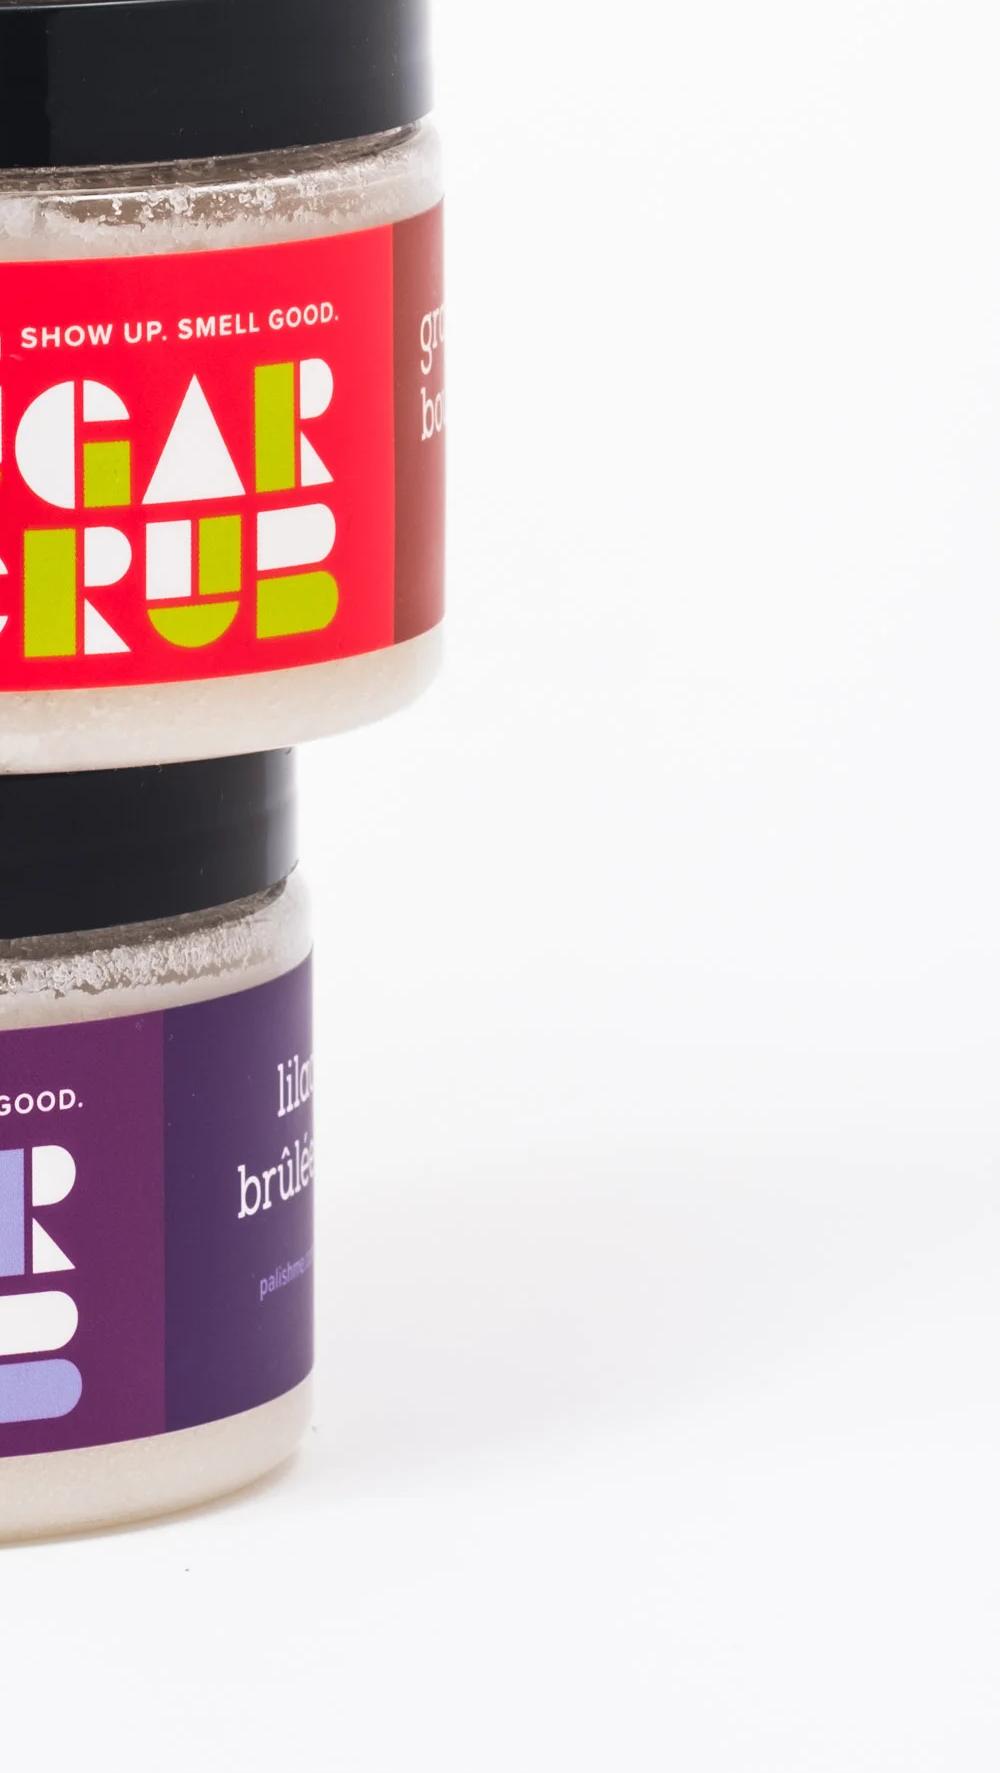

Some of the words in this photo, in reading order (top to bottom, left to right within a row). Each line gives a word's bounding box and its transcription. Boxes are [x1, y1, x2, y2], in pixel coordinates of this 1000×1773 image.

[21, 324, 113, 349] SHOW
[124, 321, 167, 344] UP.
[178, 312, 260, 340] SMELL
[269, 302, 338, 330] GOOD.
